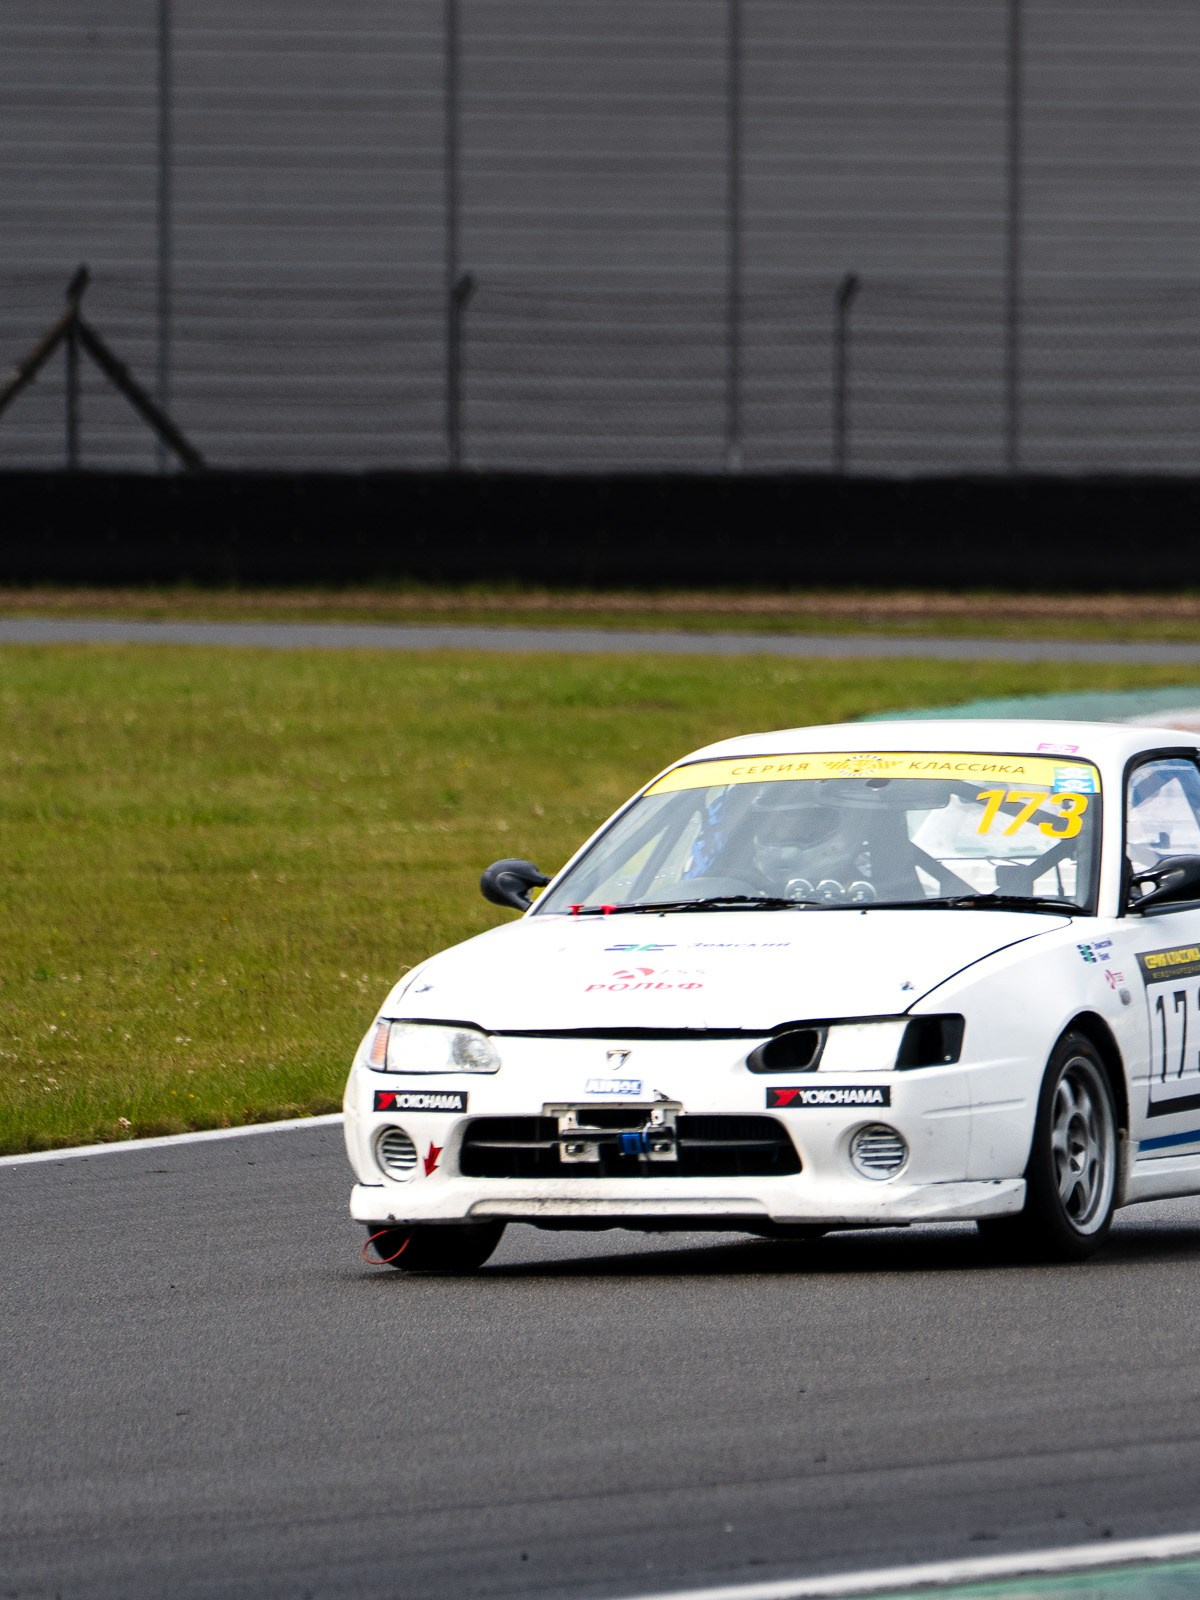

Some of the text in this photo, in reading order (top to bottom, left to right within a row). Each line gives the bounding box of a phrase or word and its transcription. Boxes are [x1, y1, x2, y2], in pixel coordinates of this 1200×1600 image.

[731, 761, 1027, 776] СЕРИЯ КЛАССИКА
[976, 789, 1089, 840] 173
[584, 982, 704, 992] РОЛЬФ
[394, 1093, 462, 1109] YOKOHAMA
[799, 1089, 884, 1104] YOKOHAMA
